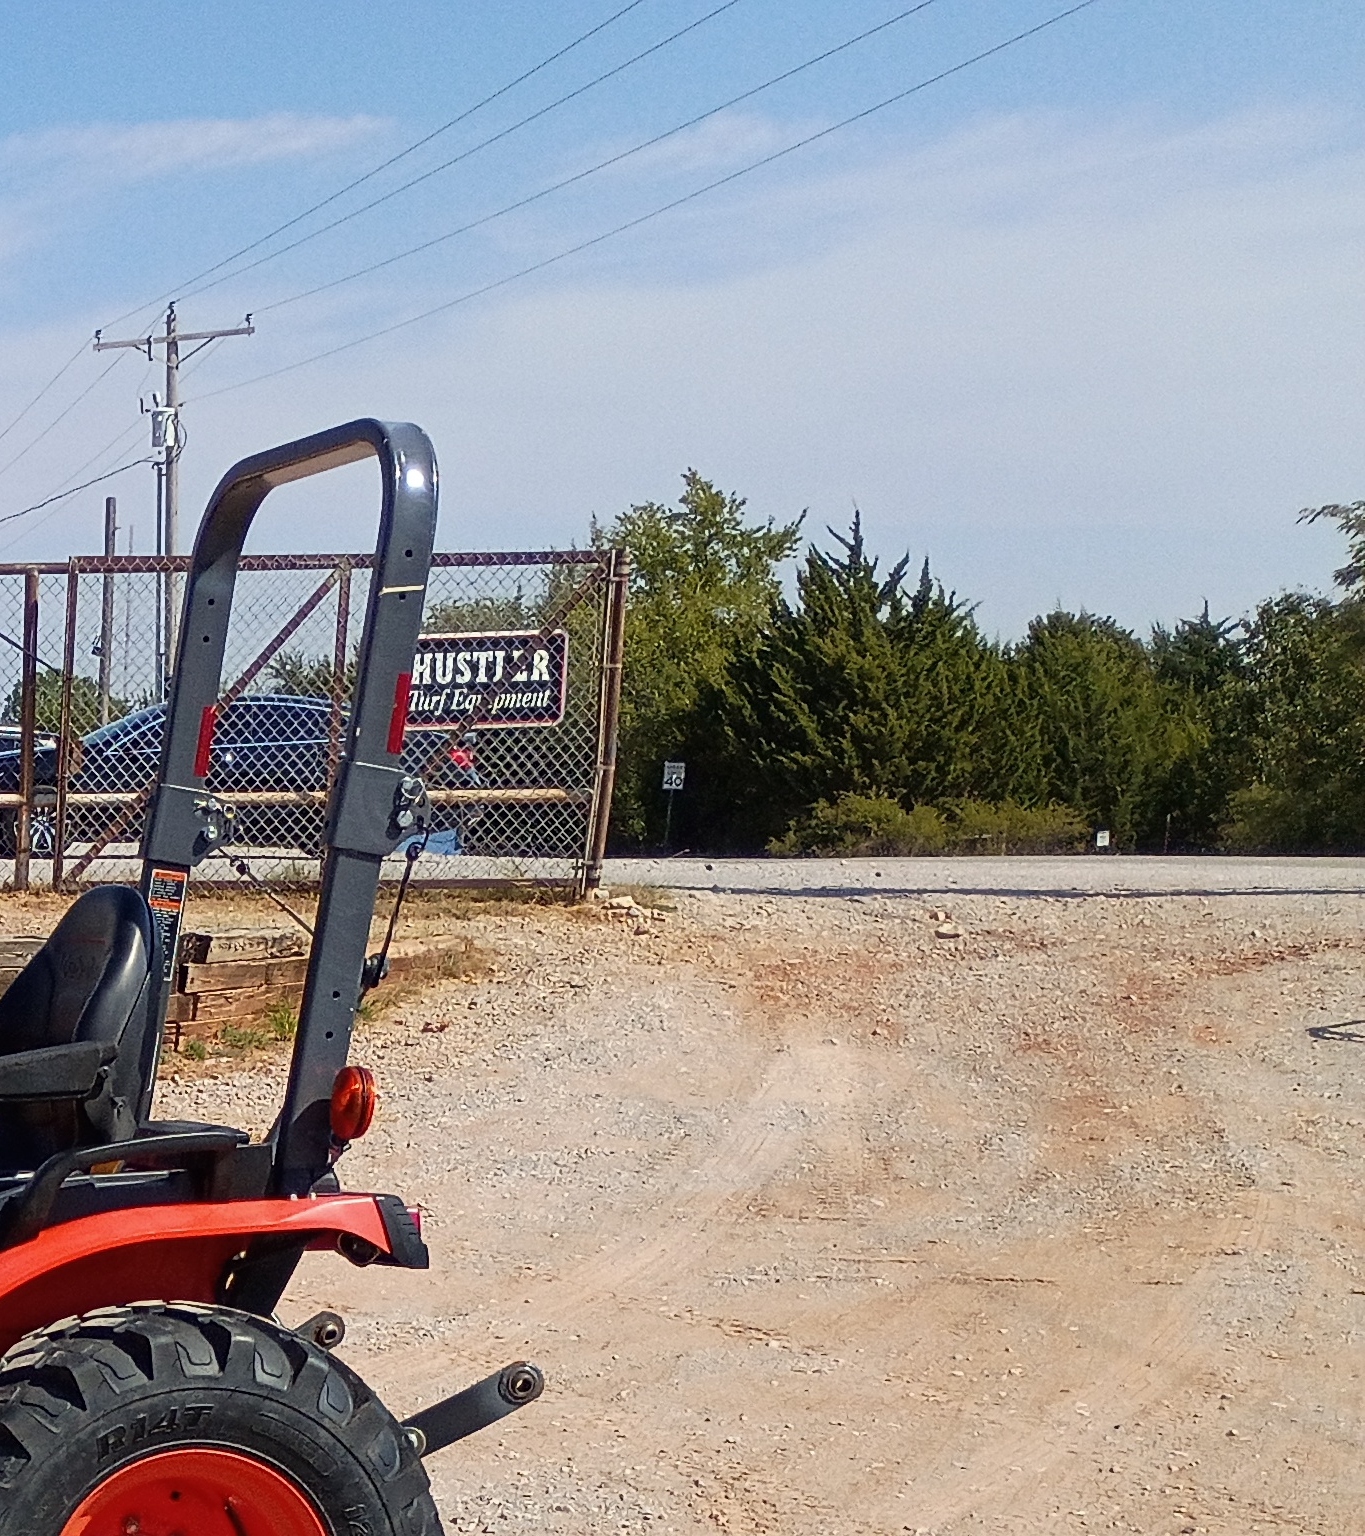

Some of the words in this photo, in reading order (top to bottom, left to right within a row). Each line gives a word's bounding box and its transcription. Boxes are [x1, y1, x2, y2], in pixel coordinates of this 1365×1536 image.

[408, 688, 451, 716] Turf
[451, 688, 551, 715] Eqpment
[664, 776, 683, 788] 40
[95, 1402, 215, 1463] R14T
